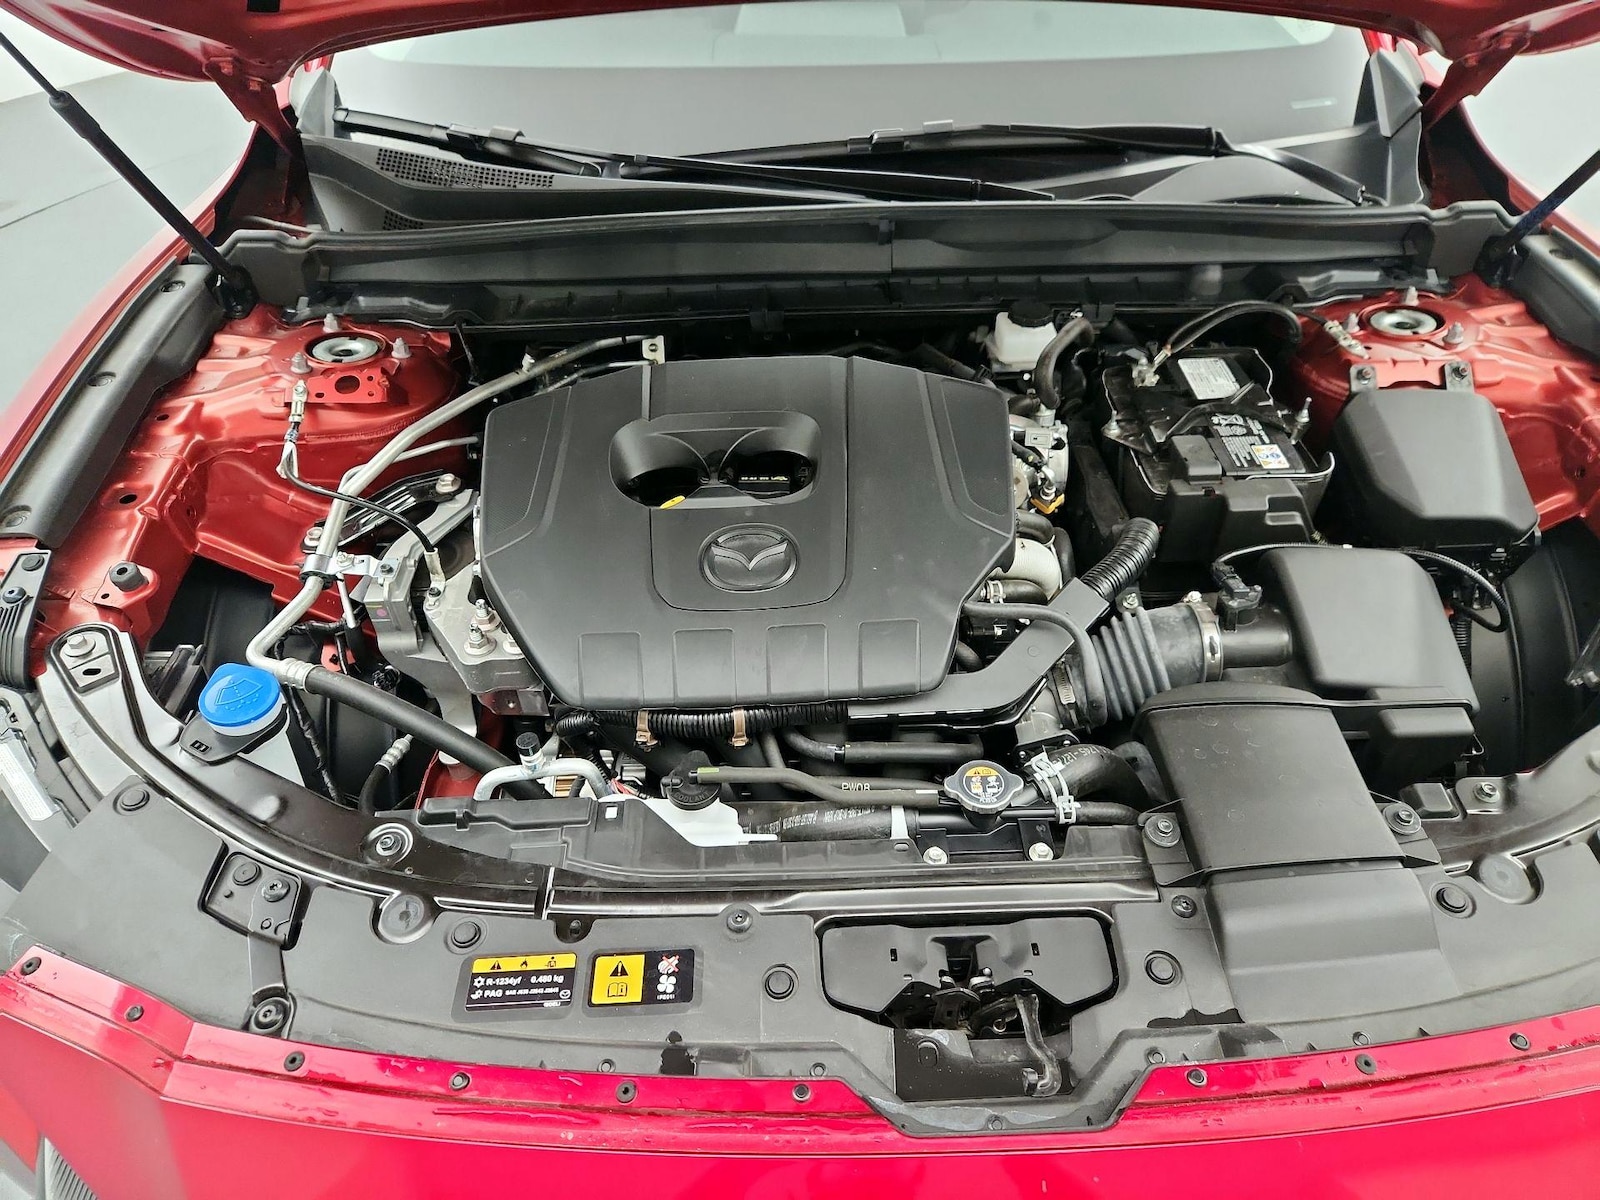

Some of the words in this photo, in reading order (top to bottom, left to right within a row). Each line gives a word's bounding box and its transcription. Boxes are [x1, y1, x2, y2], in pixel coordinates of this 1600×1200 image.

[674, 791, 710, 803] COOLANT
[486, 976, 522, 986] R-1234yf
[553, 975, 564, 983] kg
[484, 989, 503, 998] PAG
